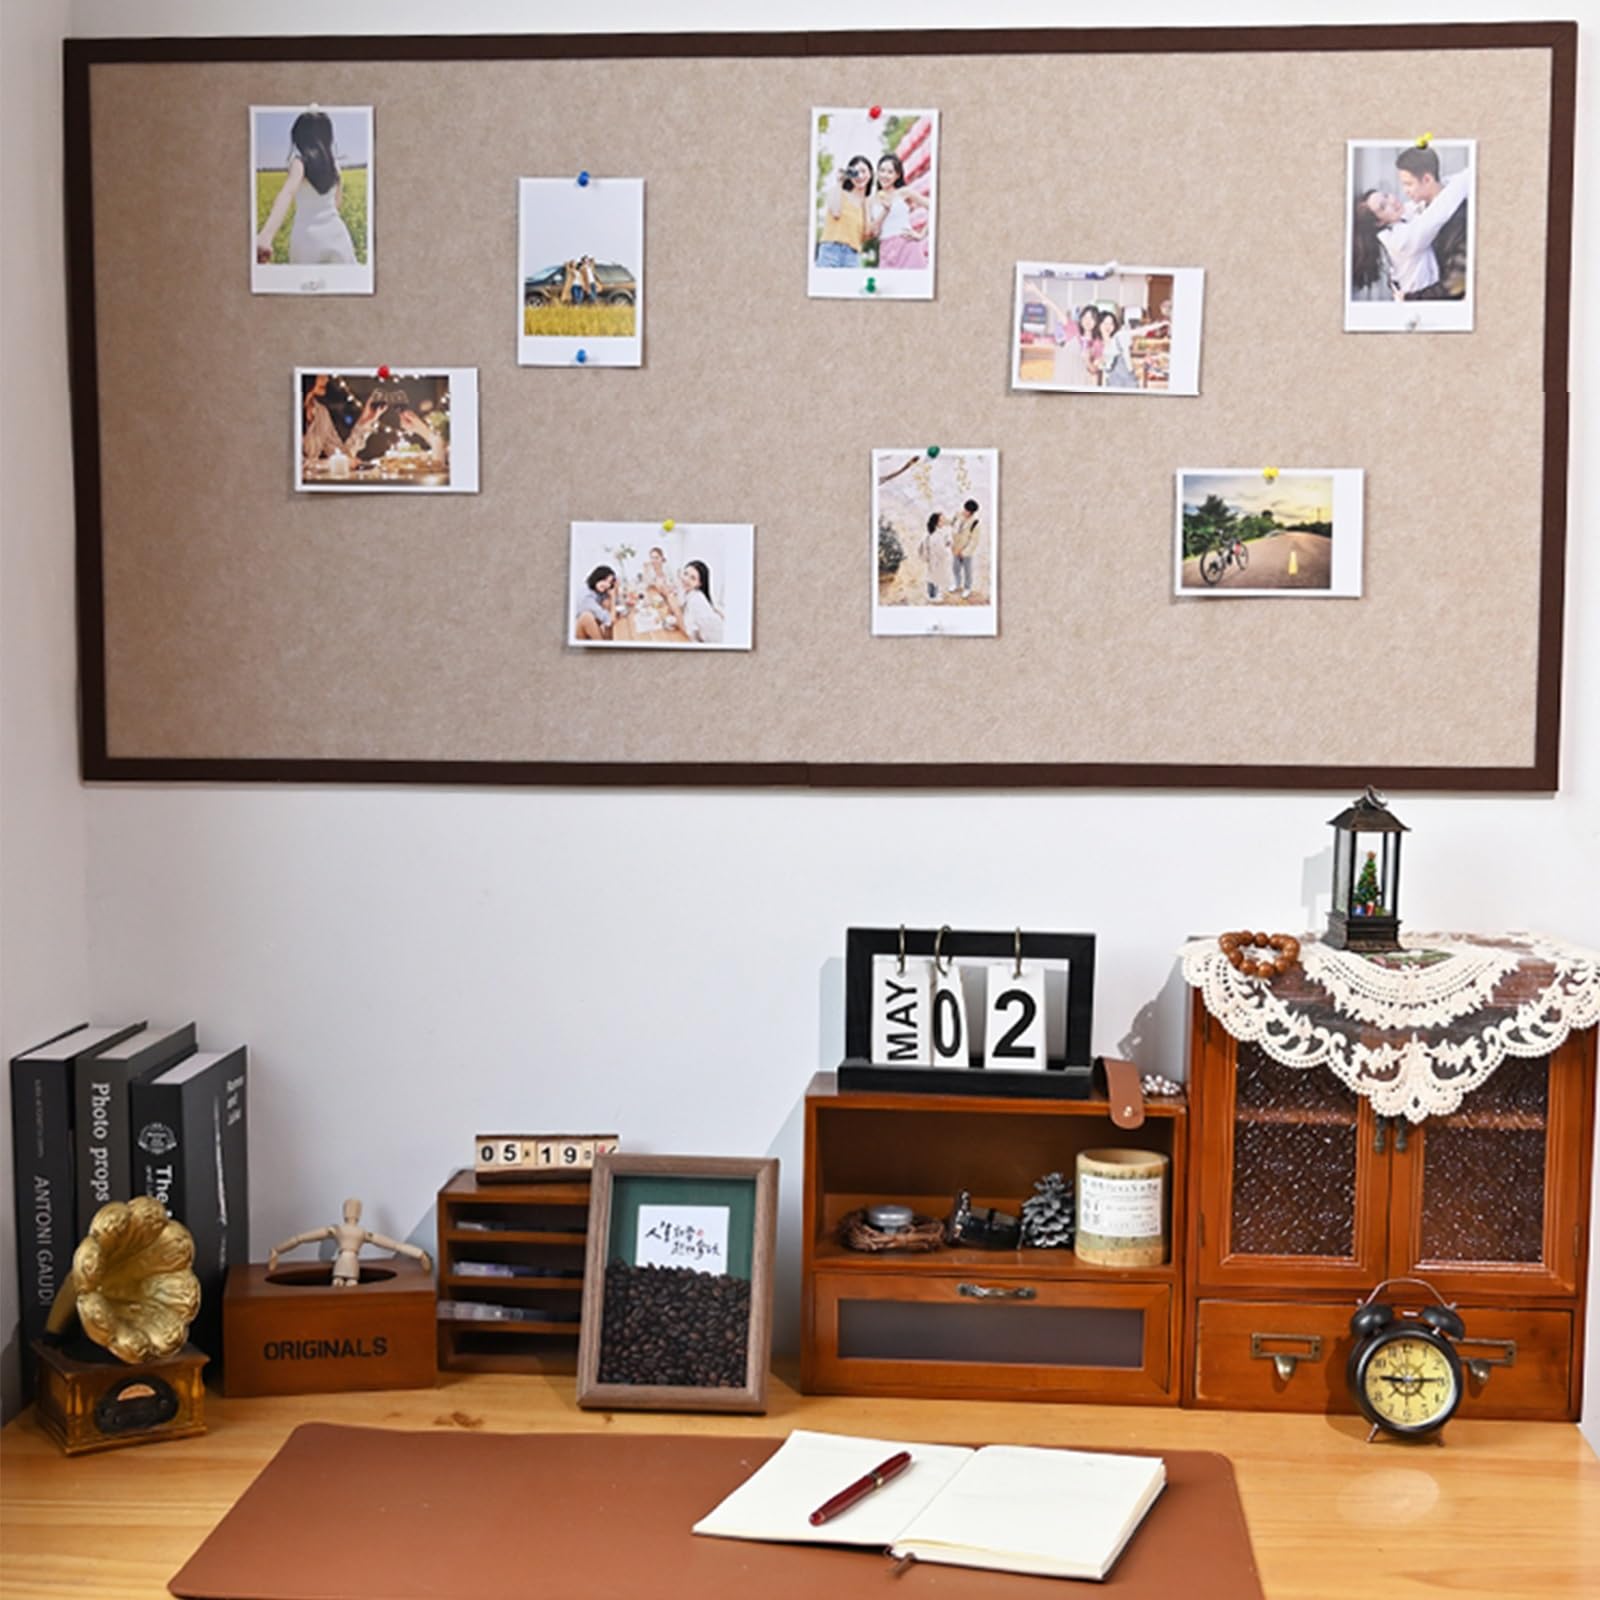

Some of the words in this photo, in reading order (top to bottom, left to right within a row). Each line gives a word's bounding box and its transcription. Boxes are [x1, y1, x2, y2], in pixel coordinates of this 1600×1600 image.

[886, 980, 918, 1061] MAY
[90, 1082, 111, 1140] Photo
[89, 1146, 111, 1202] props
[155, 1164, 173, 1204] The
[33, 1175, 53, 1245] ANTONI
[264, 1337, 388, 1361] ORIGINALS
